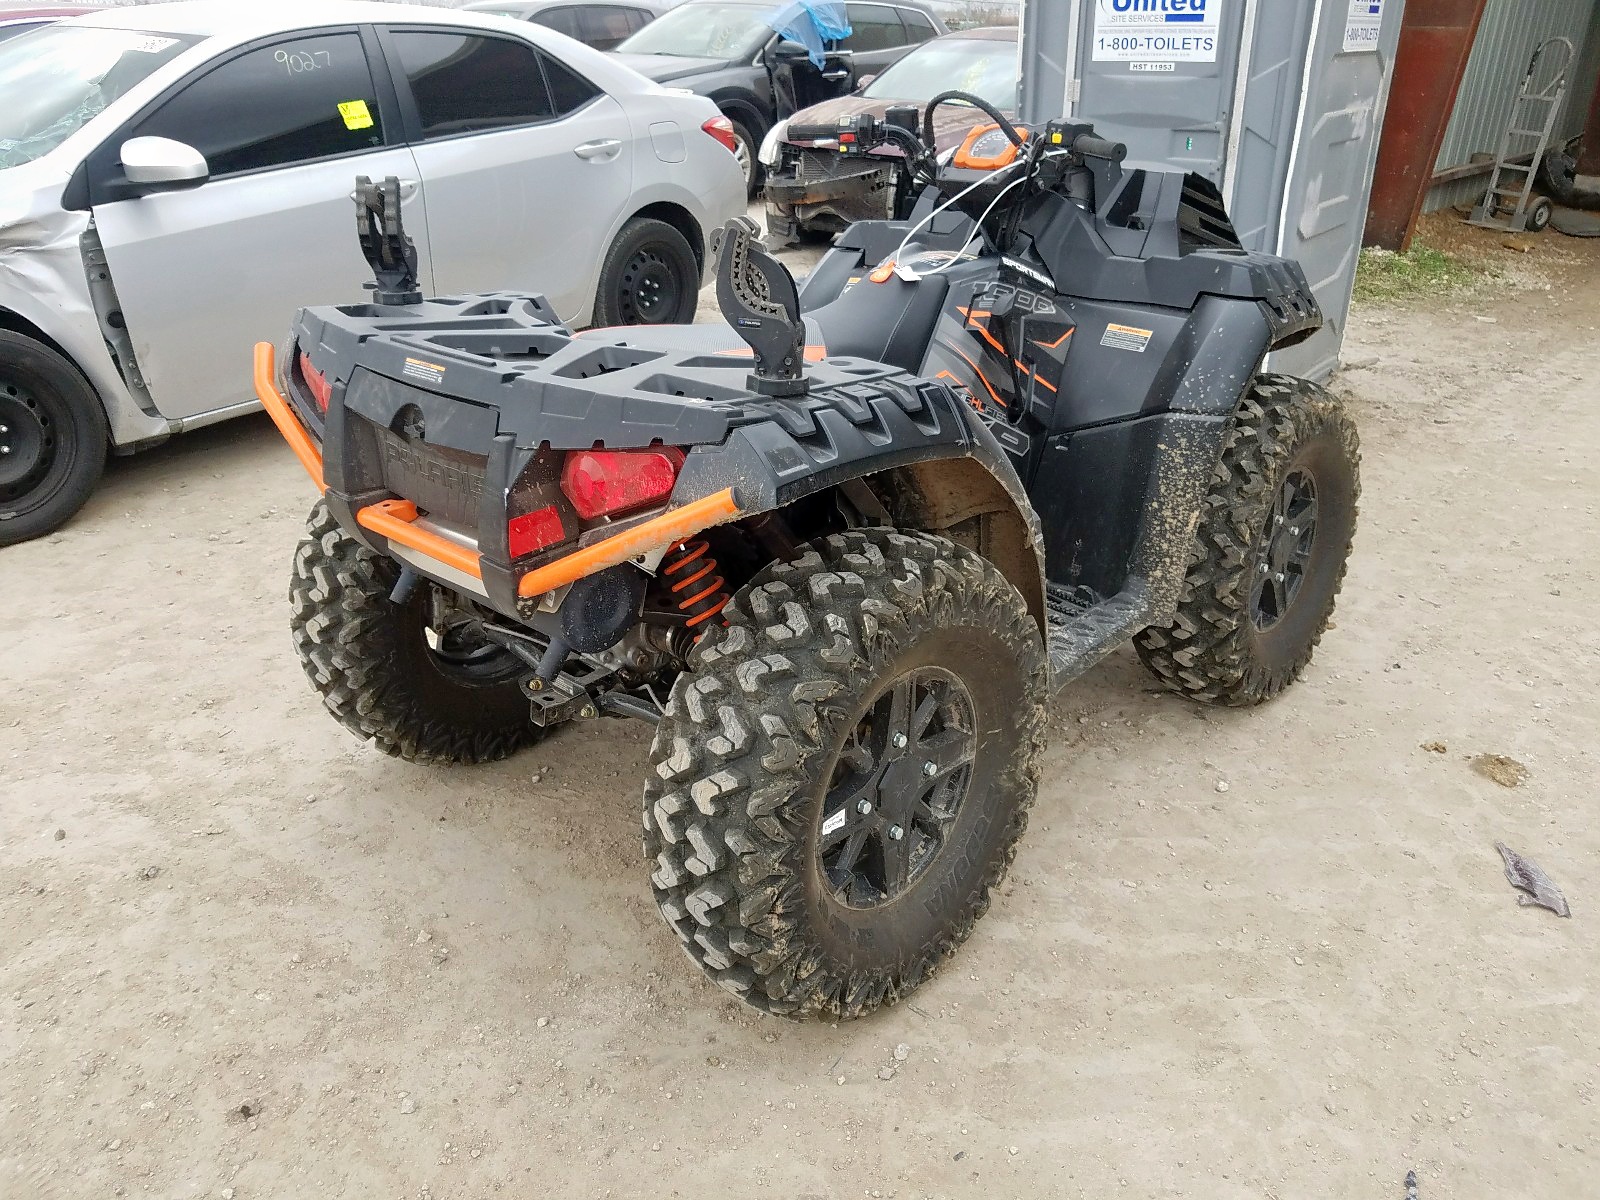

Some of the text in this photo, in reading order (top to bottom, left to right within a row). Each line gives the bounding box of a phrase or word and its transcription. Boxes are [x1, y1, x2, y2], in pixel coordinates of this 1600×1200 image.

[1112, 0, 1206, 12] United
[1111, 14, 1164, 23] SITE SERVICES
[1098, 37, 1213, 51] 1-800-TOILETS
[274, 50, 331, 76] 9027
